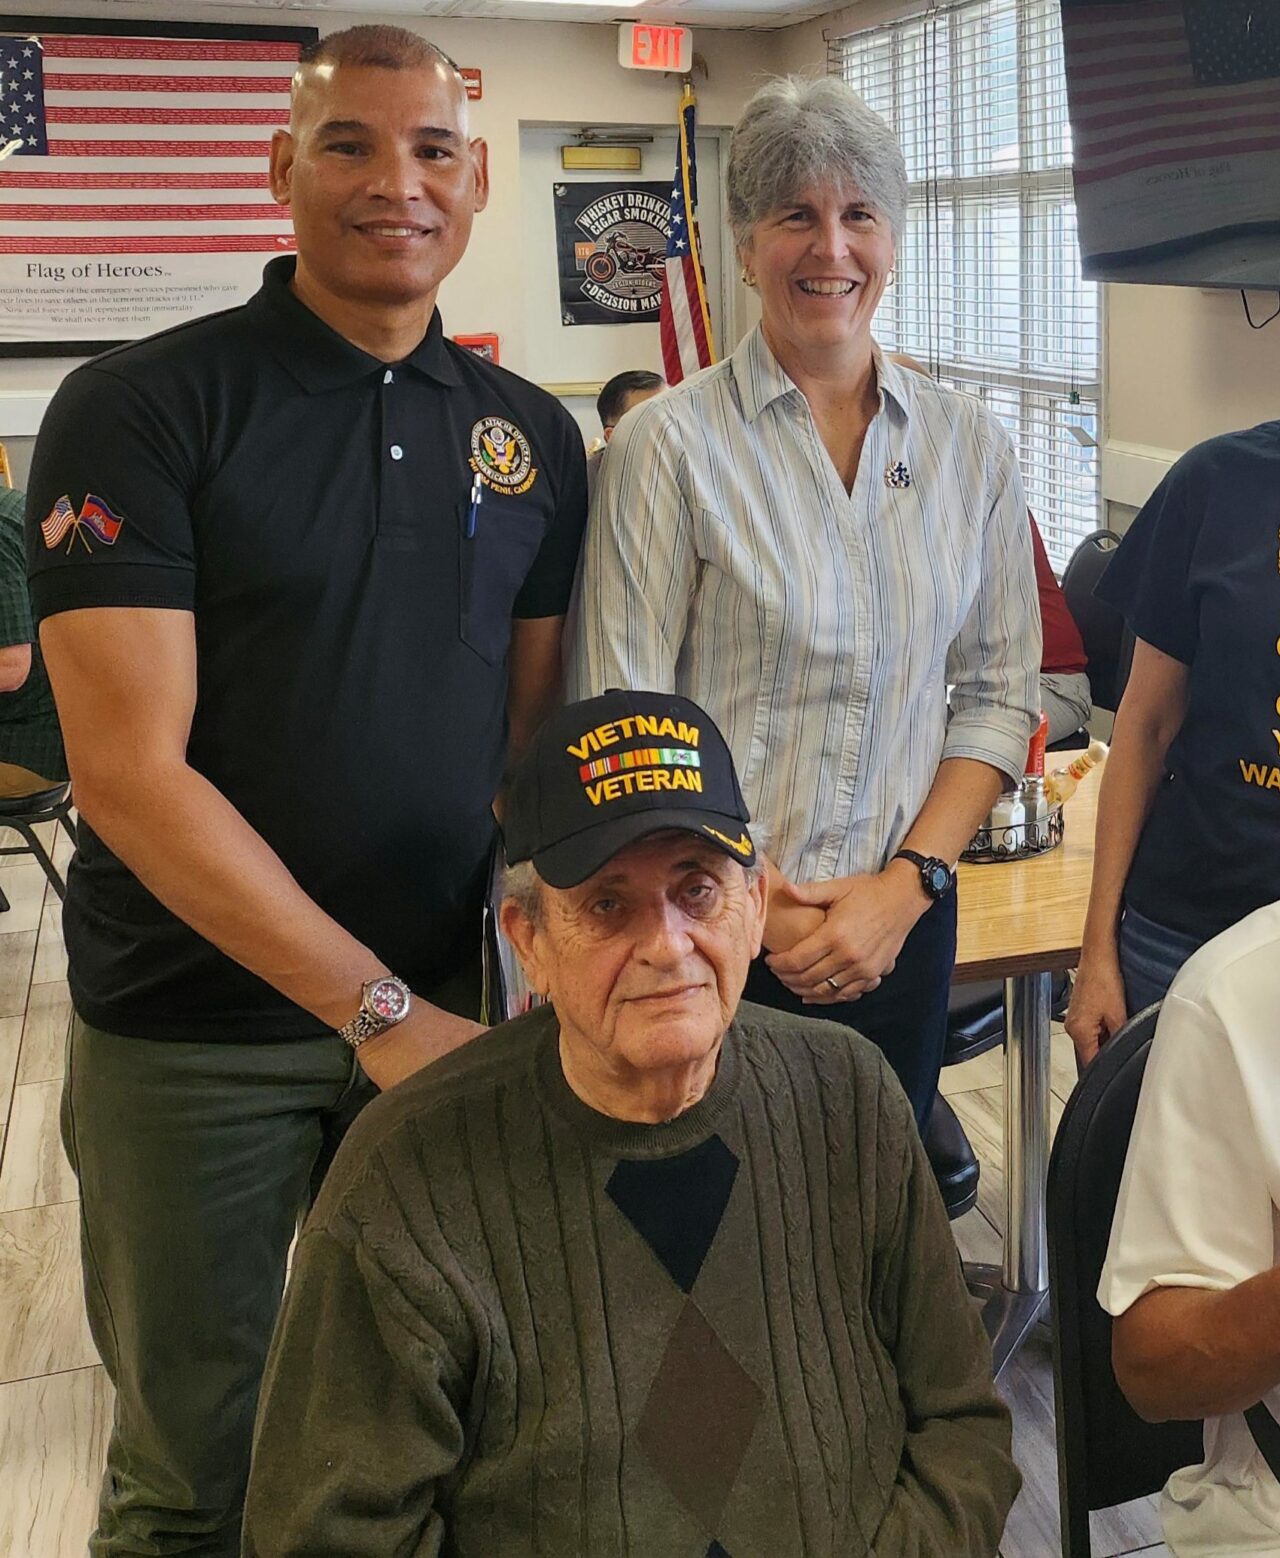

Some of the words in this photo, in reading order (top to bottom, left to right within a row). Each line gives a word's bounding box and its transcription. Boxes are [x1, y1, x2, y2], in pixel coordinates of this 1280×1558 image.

[632, 25, 684, 68] EXIT
[580, 194, 625, 228] WHISKEY
[590, 210, 622, 235] CIGAR
[26, 263, 65, 281] Flag
[72, 263, 92, 278] of
[97, 263, 162, 278] Heroes
[588, 284, 637, 311] DECISION
[566, 714, 700, 761] VIETNAM
[585, 768, 702, 806] VETERAN
